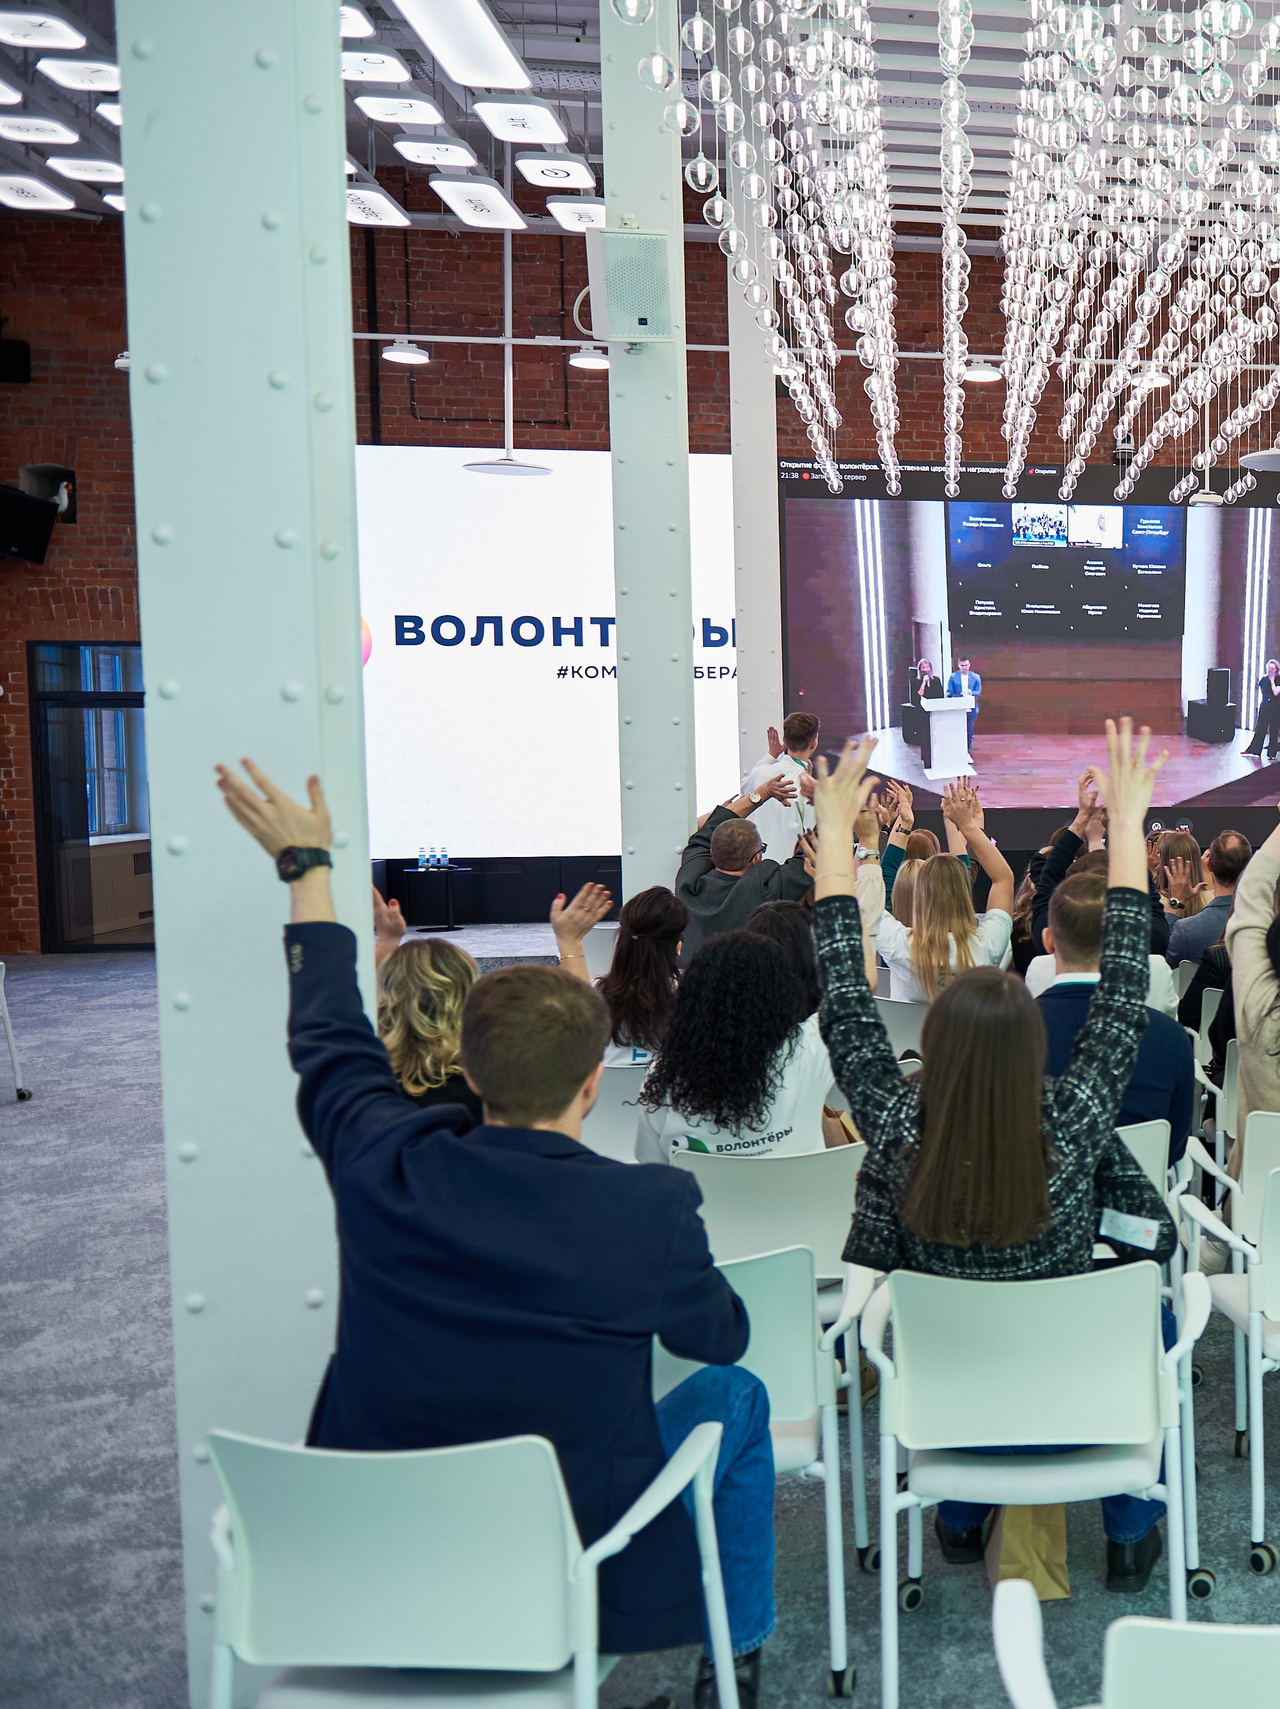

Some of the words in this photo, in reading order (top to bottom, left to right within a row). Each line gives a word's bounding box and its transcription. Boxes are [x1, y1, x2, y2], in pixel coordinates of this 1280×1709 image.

[780, 461, 813, 470] Открытие
[813, 462, 839, 471] фоа
[839, 463, 880, 472] волонтёров.
[967, 466, 1009, 475] награждени
[395, 614, 737, 647] волонты
[556, 665, 738, 680] #КОМБЕРА
[715, 1126, 794, 1153] волонтёры
